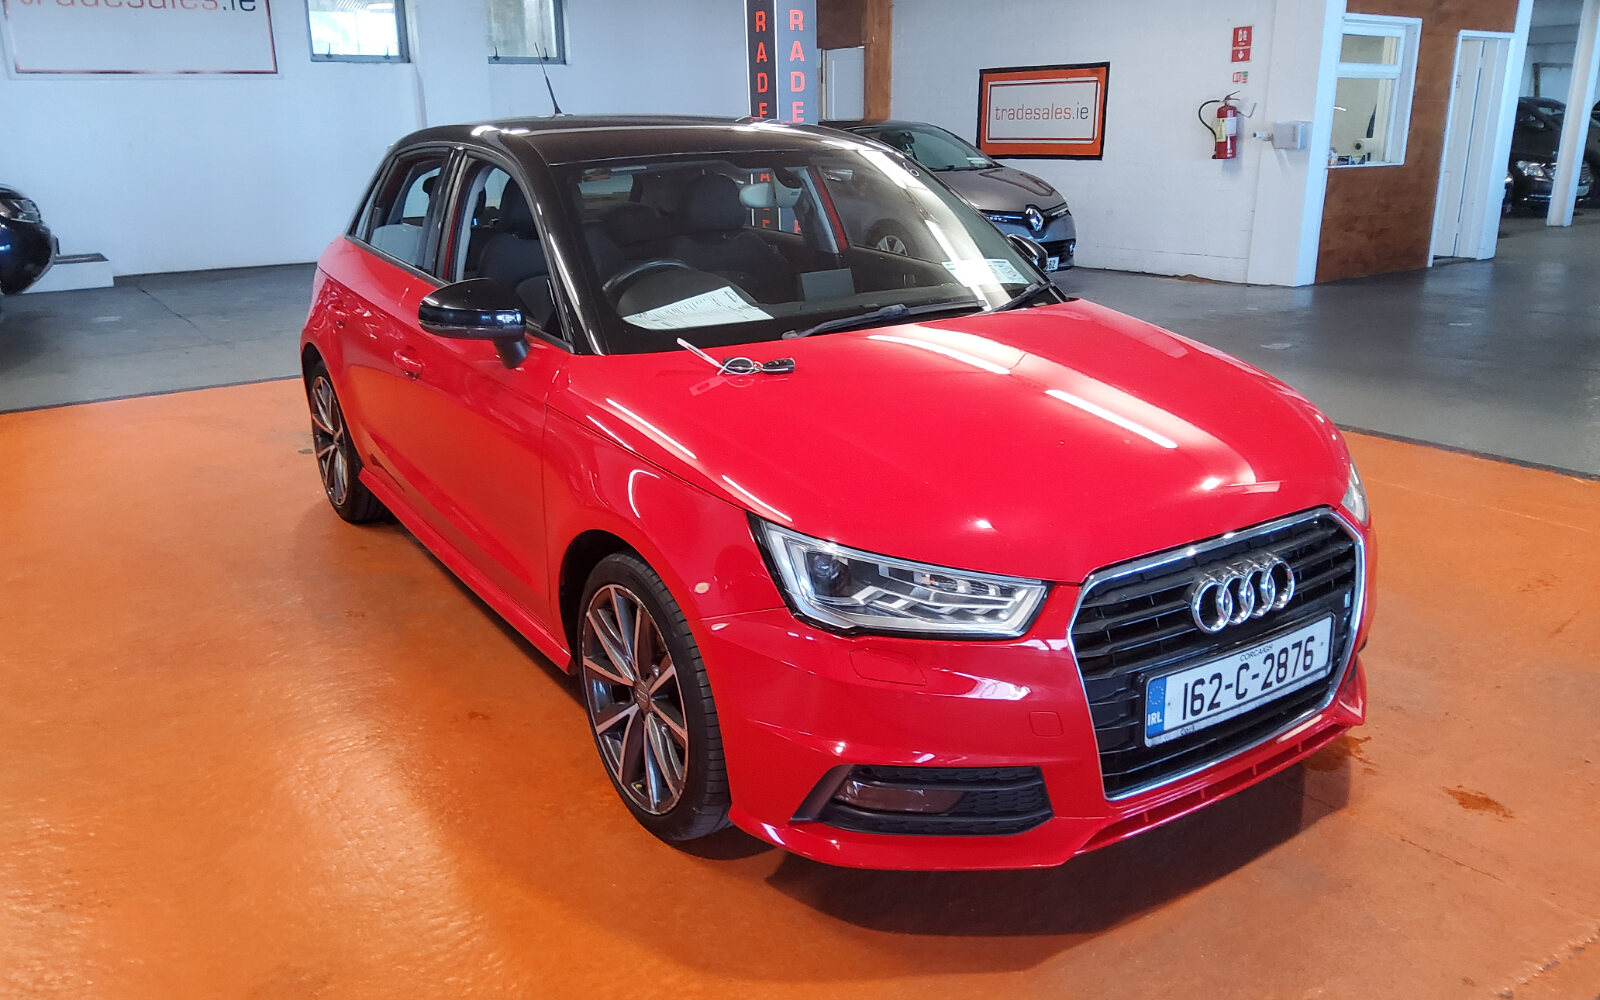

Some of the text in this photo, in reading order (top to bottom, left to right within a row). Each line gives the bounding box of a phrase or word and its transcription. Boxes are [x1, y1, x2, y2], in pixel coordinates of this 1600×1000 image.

[755, 0, 768, 119] RADE
[995, 102, 1089, 121] tradesales.ie
[1182, 635, 1315, 720] 162-C-2876
[1147, 711, 1163, 726] IRL
